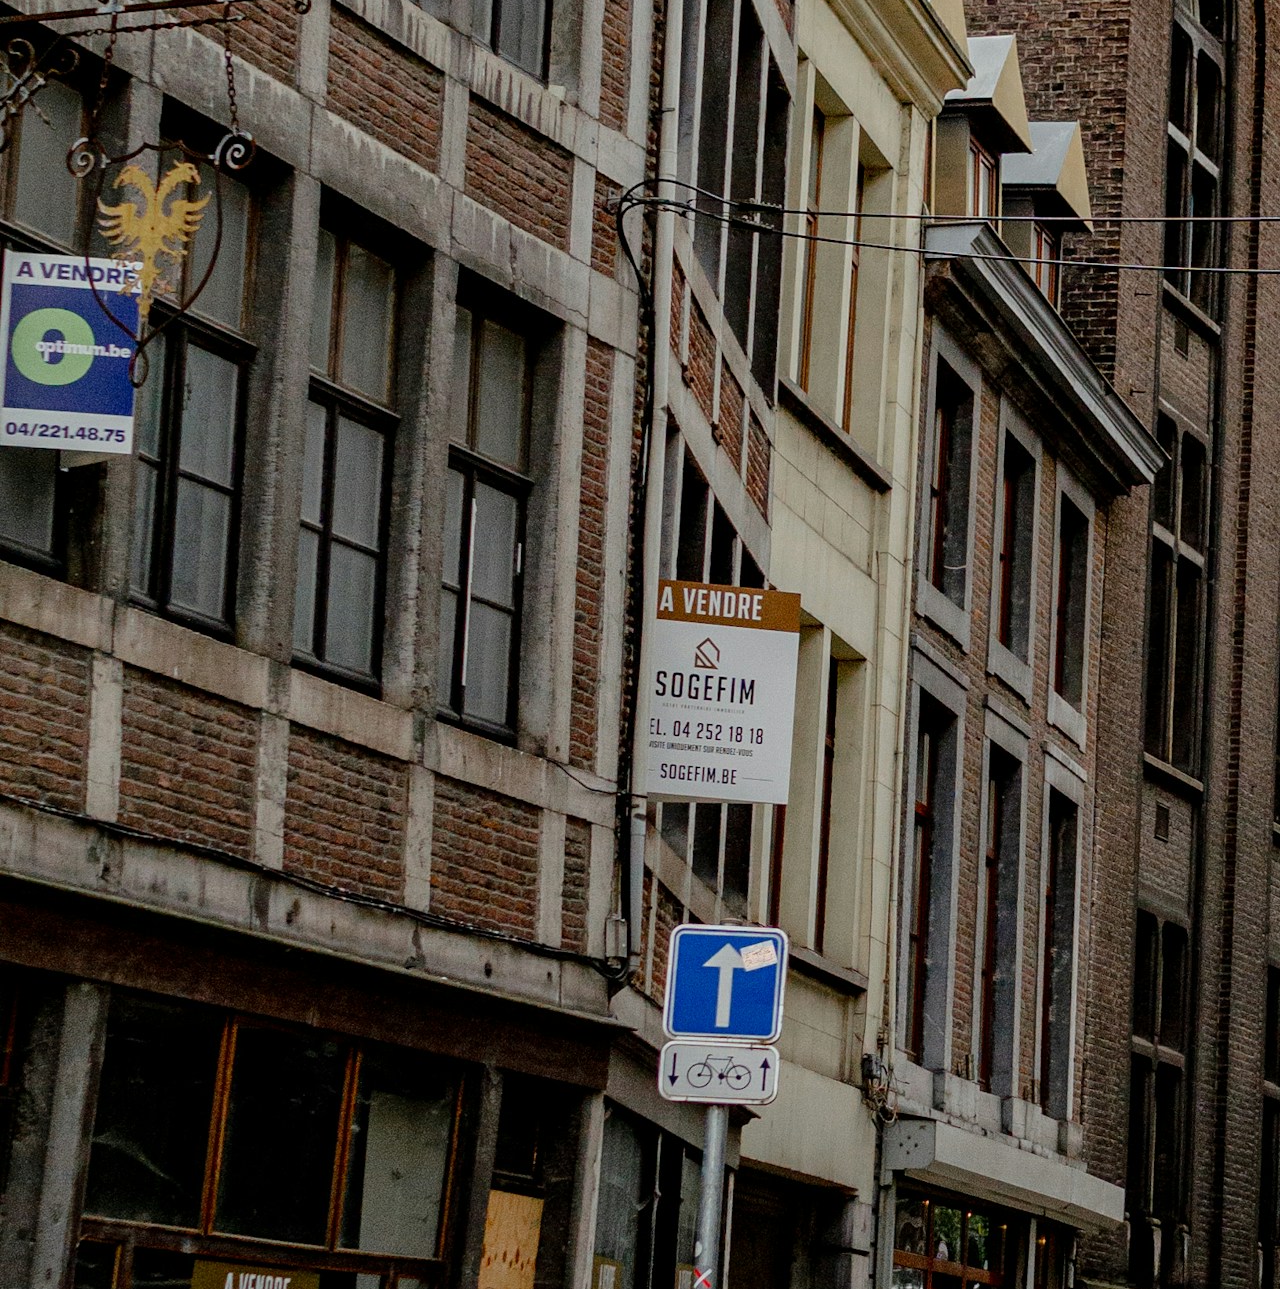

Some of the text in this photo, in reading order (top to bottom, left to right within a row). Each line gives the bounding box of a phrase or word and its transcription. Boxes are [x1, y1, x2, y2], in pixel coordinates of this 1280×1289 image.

[17, 261, 138, 285] A VENDRE
[35, 339, 132, 362] optimum.be
[5, 421, 126, 443] 04/221.48.75
[659, 586, 764, 621] A VENDRE
[655, 670, 756, 705] SOGEFIM
[650, 718, 764, 745] EL. 04 252 18 18
[667, 742, 702, 752] UNIQUEMENT
[703, 745, 715, 753] SUR
[716, 746, 753, 757] RENDEZ-VOUS
[660, 763, 738, 785] SOGEFIM.BE
